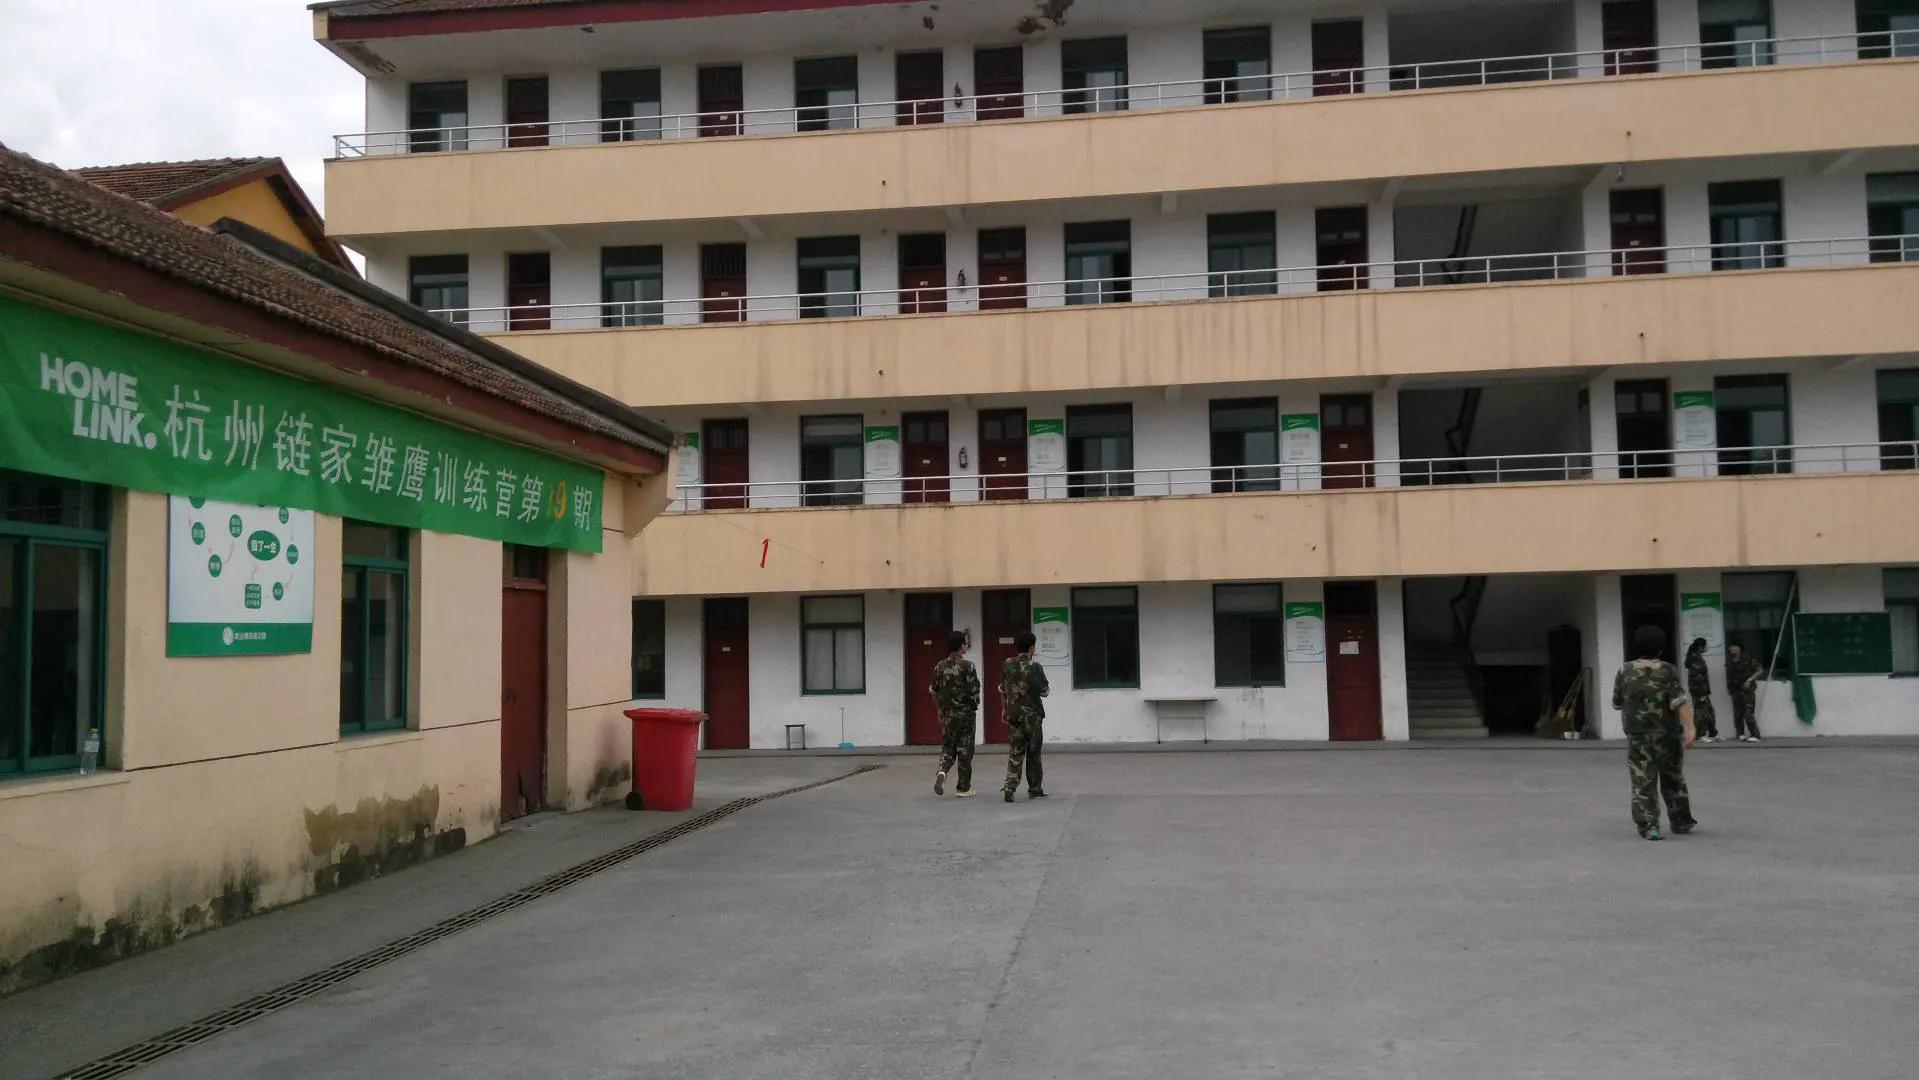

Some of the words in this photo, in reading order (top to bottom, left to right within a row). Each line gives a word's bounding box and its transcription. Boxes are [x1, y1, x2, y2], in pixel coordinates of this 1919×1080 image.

[40, 352, 138, 411] HOME
[73, 399, 158, 450] LINK.
[163, 383, 594, 530] 杭州链家雏鹰训练营第19期
